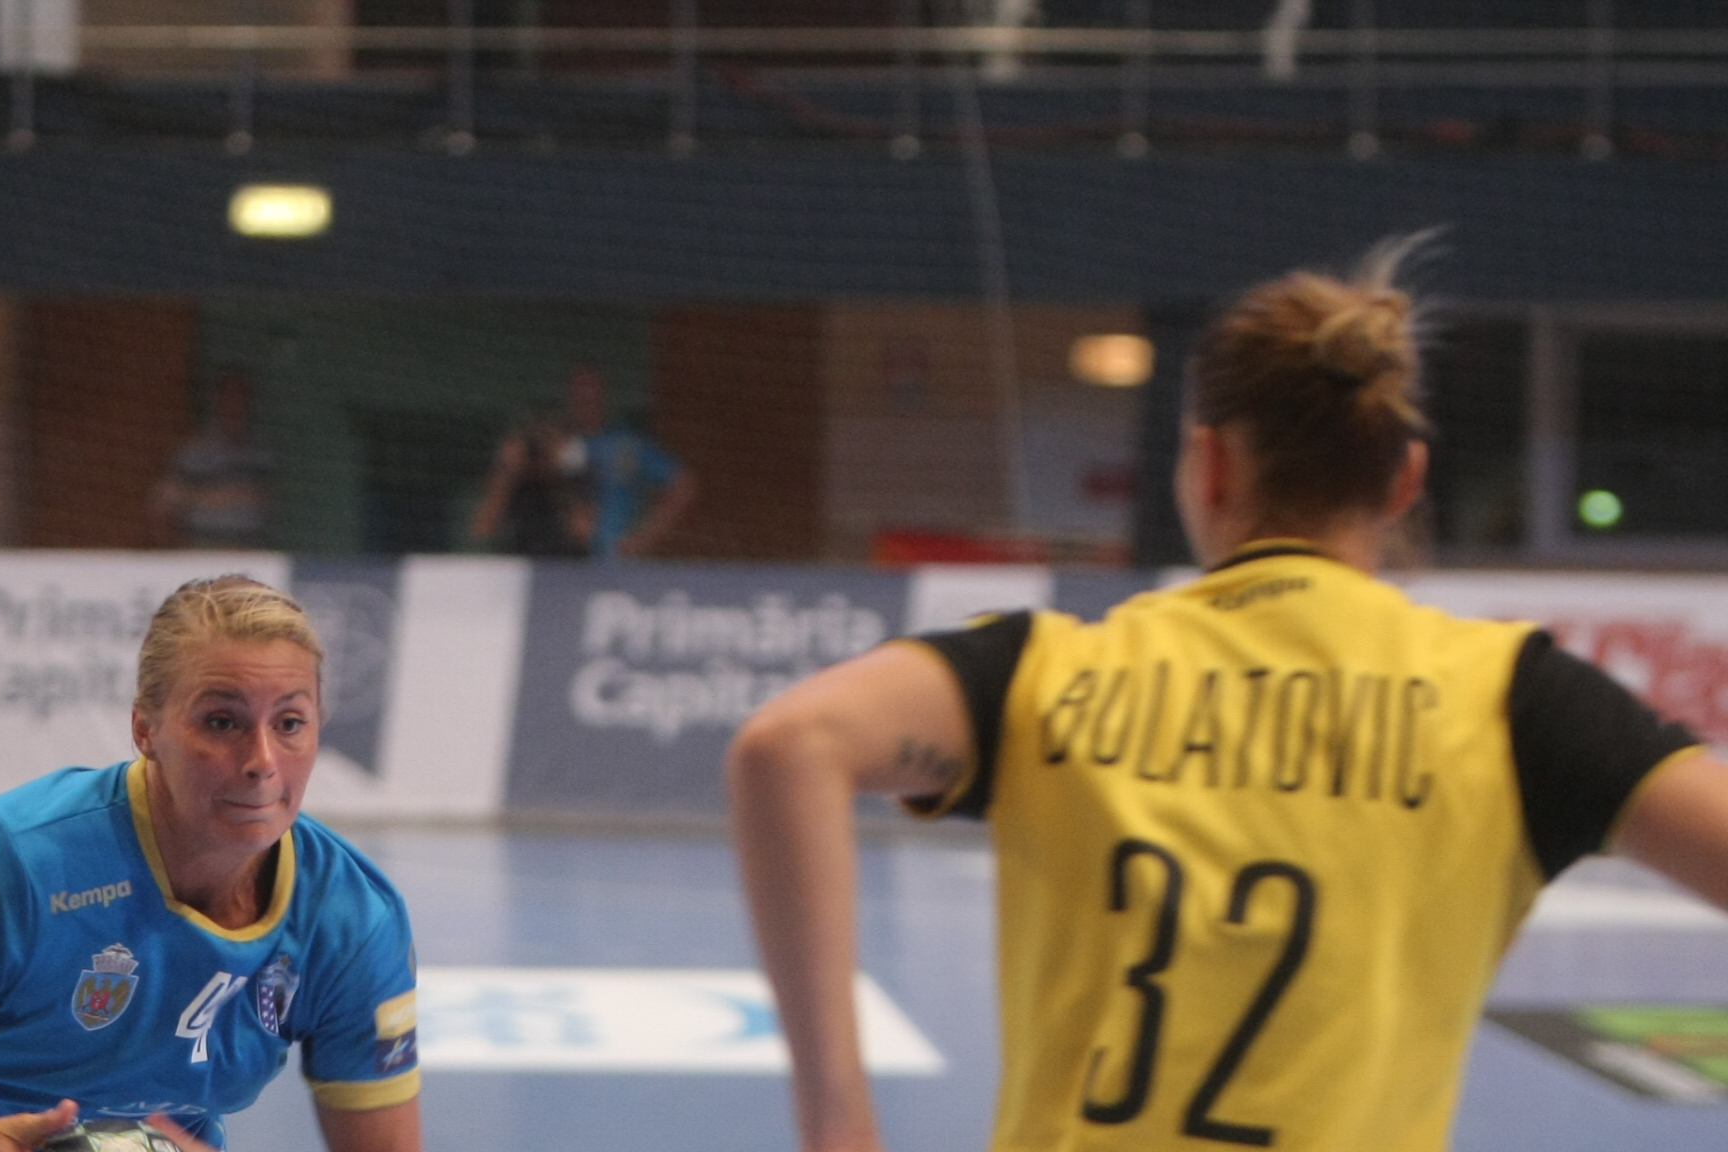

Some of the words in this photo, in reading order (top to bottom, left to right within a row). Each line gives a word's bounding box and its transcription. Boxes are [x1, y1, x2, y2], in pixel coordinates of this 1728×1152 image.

[1042, 664, 1441, 810] BULATOVIC
[50, 880, 132, 914] Kempa
[1081, 836, 1318, 1148] 32
